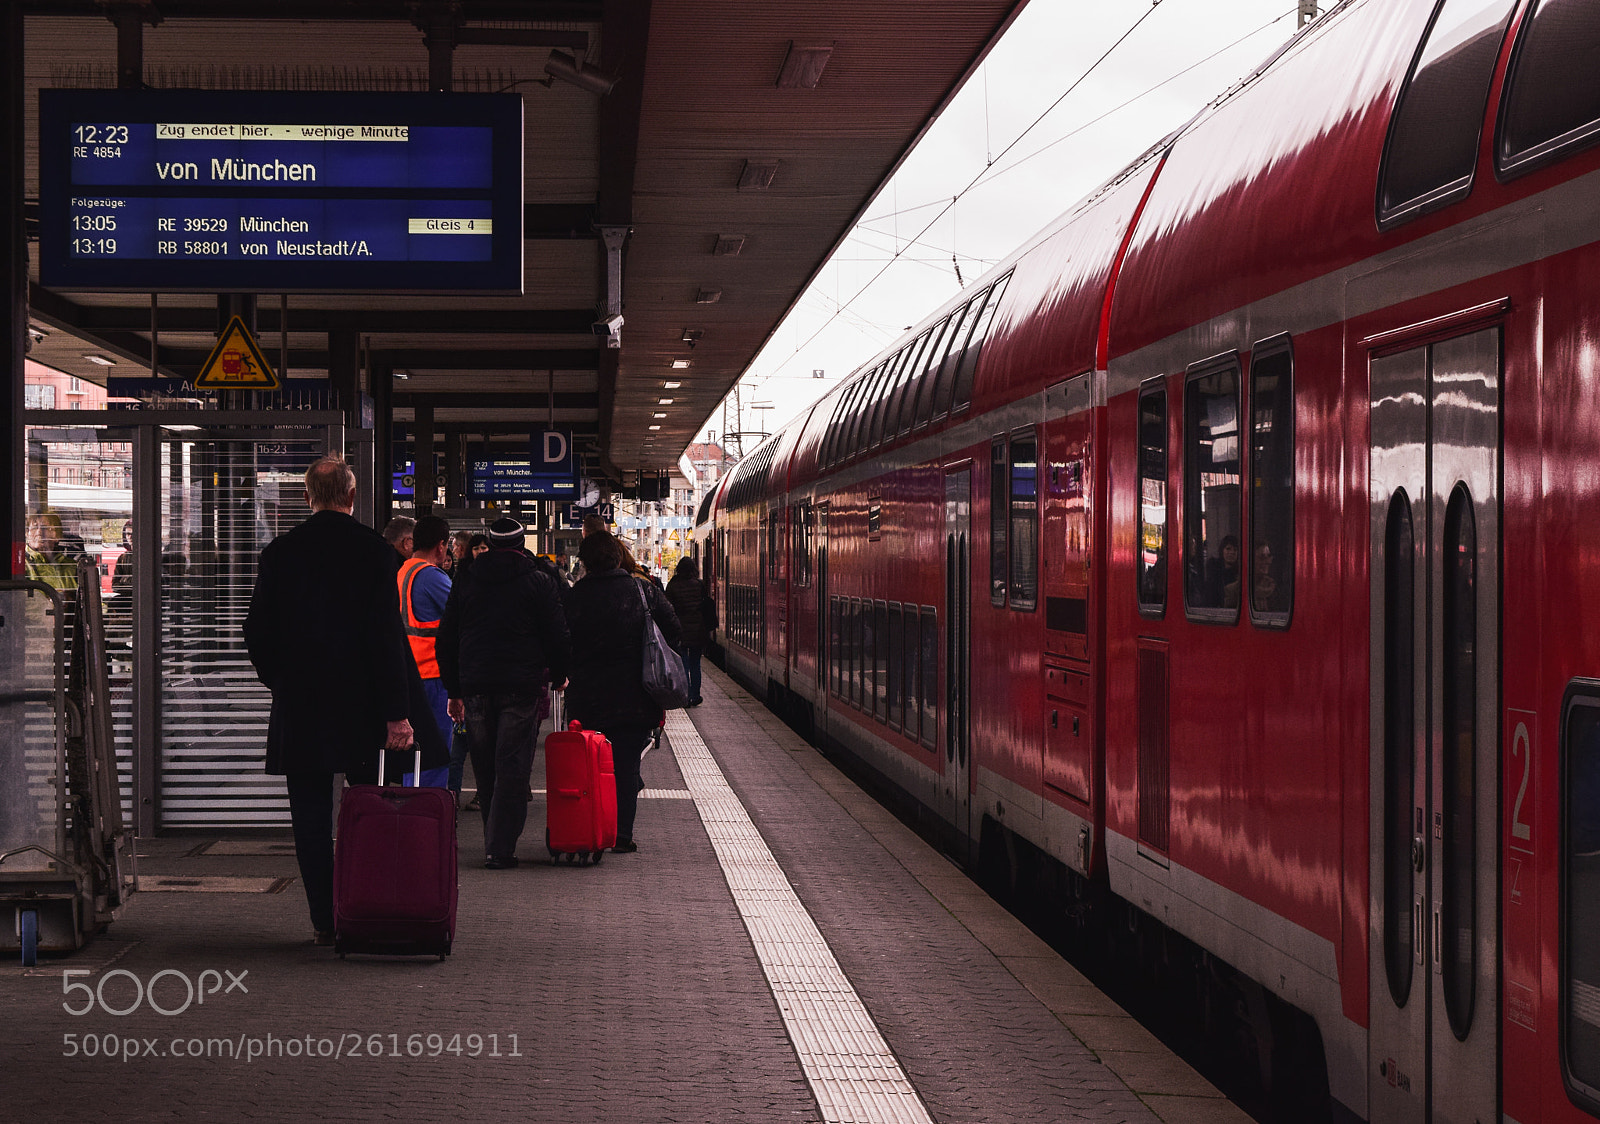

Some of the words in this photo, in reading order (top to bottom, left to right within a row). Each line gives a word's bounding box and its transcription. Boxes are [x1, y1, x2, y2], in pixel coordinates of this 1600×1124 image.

[74, 125, 129, 144] 12:23
[159, 124, 185, 138] Zug
[191, 124, 236, 136] endet
[241, 125, 273, 137] hier.
[301, 126, 355, 140] wenige
[361, 126, 409, 138] Minute
[73, 146, 88, 158] RE
[93, 146, 121, 158] 4854
[156, 161, 198, 180] von
[211, 158, 316, 181] München
[71, 197, 126, 209] Folgezüge:
[72, 215, 117, 231] 13:05
[158, 218, 177, 232] RE
[183, 218, 228, 232] 39529
[240, 216, 309, 232] München
[426, 219, 461, 231] Gleis
[467, 219, 475, 231] 4
[72, 238, 117, 254] 13:19
[158, 241, 177, 255] RB
[184, 241, 229, 255] 58801
[240, 243, 268, 255] von
[276, 240, 373, 256] Neustadt/A.
[258, 444, 288, 455] 16-23
[543, 431, 567, 463] D
[569, 504, 581, 520] E
[593, 503, 612, 520] 14
[1511, 721, 1530, 841] 2
